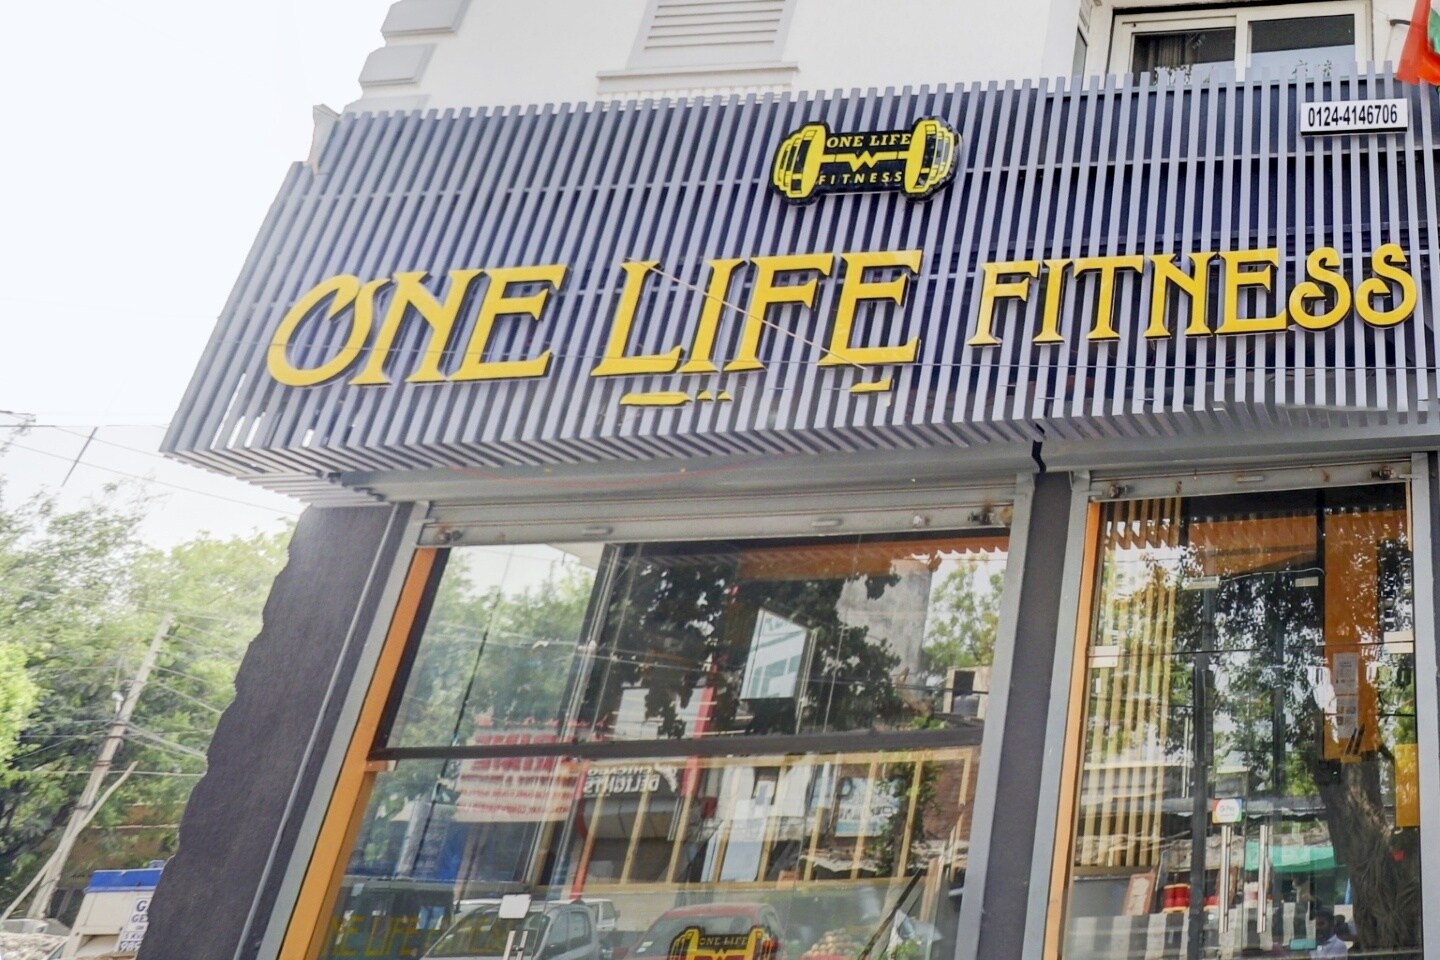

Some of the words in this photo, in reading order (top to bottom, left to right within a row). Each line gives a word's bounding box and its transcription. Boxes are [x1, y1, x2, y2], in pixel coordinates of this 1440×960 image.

[1308, 104, 1398, 127] 0124-4146706
[826, 135, 864, 148] ONE
[869, 133, 911, 147] LIFE
[818, 171, 903, 185] FITNESS
[266, 264, 568, 387] ONE
[591, 249, 924, 375] LIFE
[966, 243, 1418, 348] FITNESS
